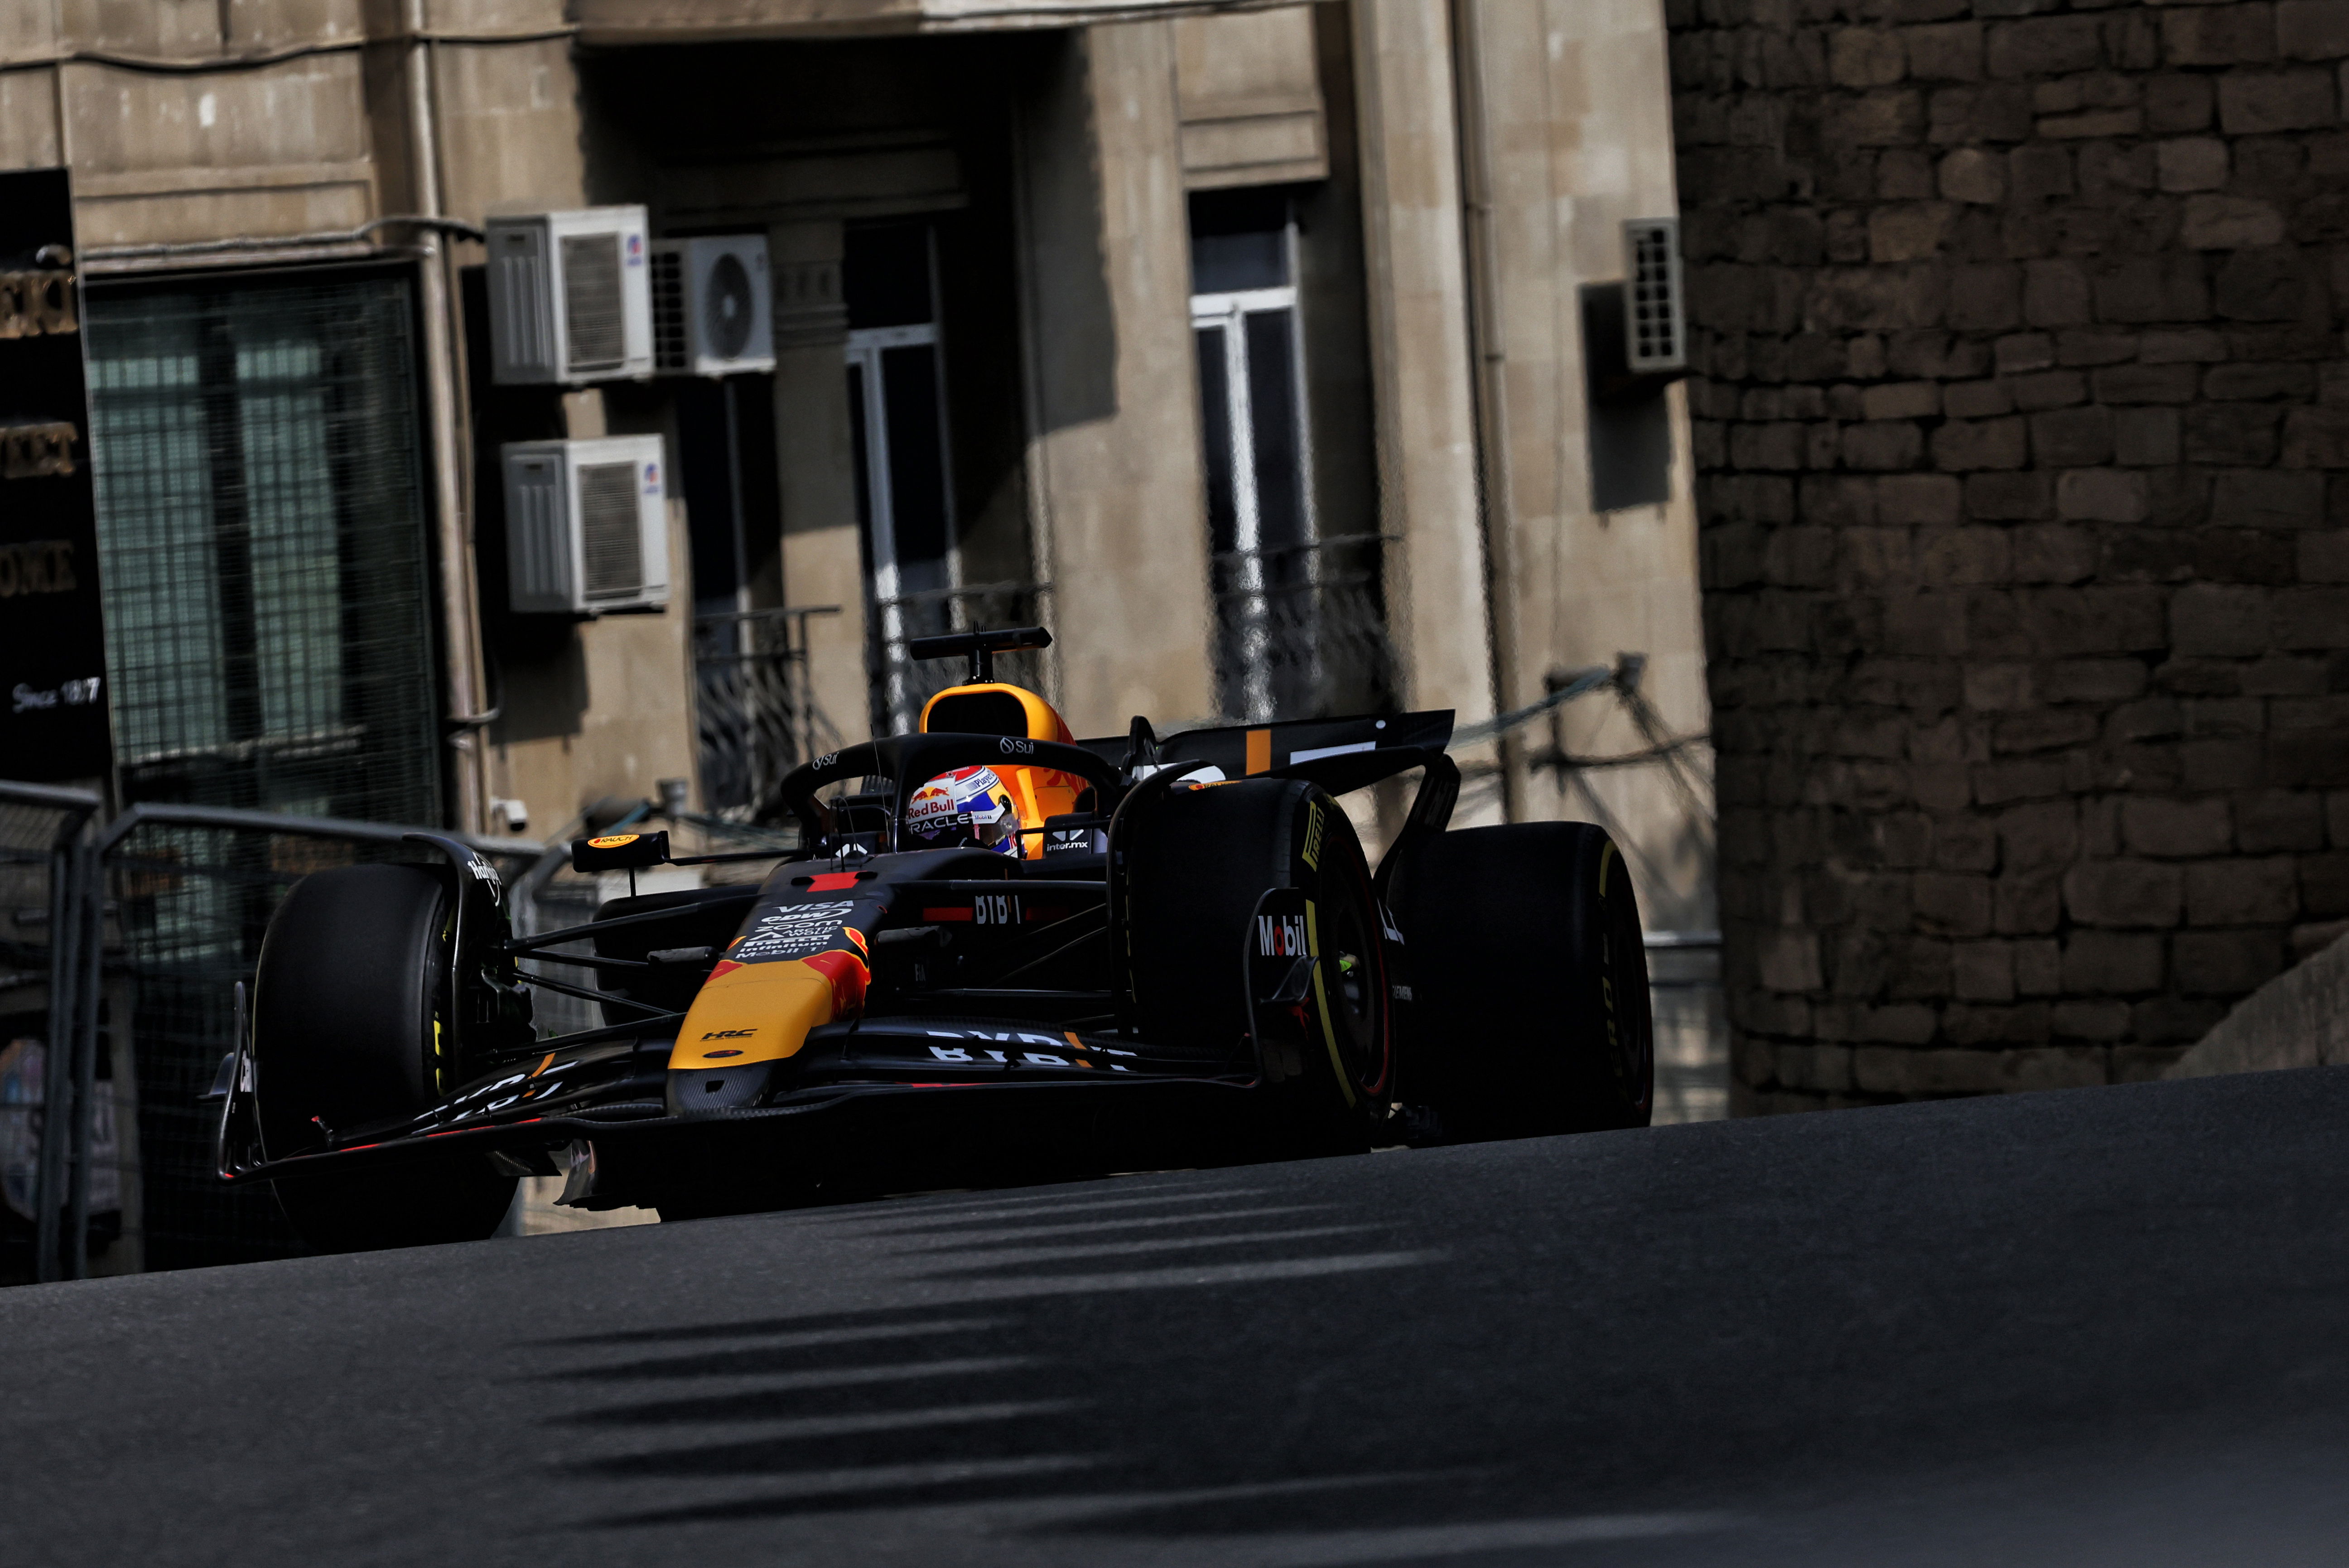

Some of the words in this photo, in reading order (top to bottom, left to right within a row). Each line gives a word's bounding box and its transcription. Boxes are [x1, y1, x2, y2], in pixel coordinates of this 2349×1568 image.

[1016, 740, 1034, 754] Sui
[908, 803, 929, 820] Red
[930, 799, 955, 813] Bull
[910, 813, 970, 835] RACLE
[1047, 841, 1088, 852] inter.mx
[772, 900, 854, 913] VISA
[761, 911, 833, 923] CDW
[782, 926, 838, 934] ARCTIC
[1258, 915, 1307, 956] Mobil
[743, 934, 833, 947] PIRELLI
[735, 947, 799, 959] Mobil
[701, 1028, 758, 1040] HRC
